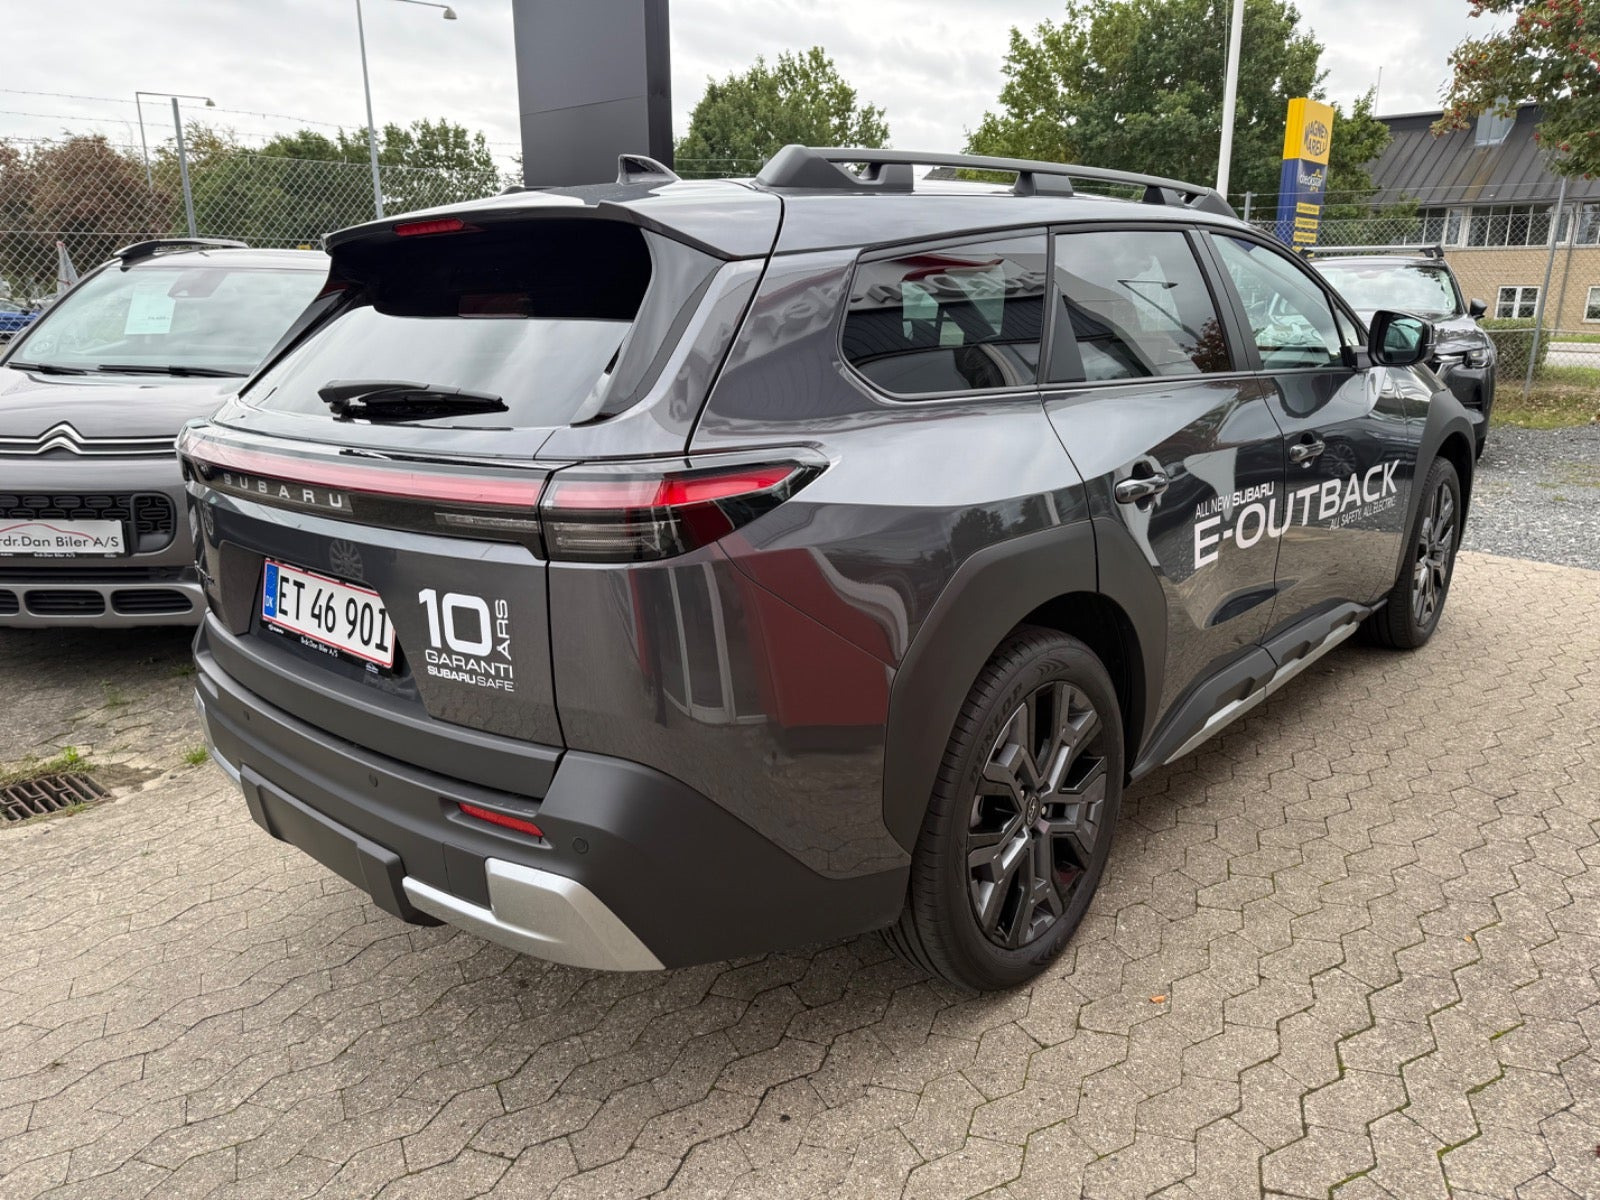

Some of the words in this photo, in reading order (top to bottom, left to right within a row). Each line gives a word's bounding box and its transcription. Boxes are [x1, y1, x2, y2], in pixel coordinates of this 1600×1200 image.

[223, 473, 343, 508] SUBARU
[1195, 501, 1210, 519] ALL
[1210, 493, 1232, 514] NEW
[1232, 481, 1275, 507] SUBARU
[1194, 459, 1400, 569] E-OUTBACK
[55, 536, 89, 548] Biler
[93, 536, 119, 549] A/S
[265, 595, 273, 608] DK
[278, 575, 306, 621] ET
[310, 588, 336, 634] 46
[345, 597, 389, 653] 901
[418, 588, 493, 657] 10
[494, 599, 512, 661] ÅRS
[425, 649, 513, 679] GARANTI
[427, 665, 477, 684] SUBARU
[476, 676, 515, 692] SAFE
